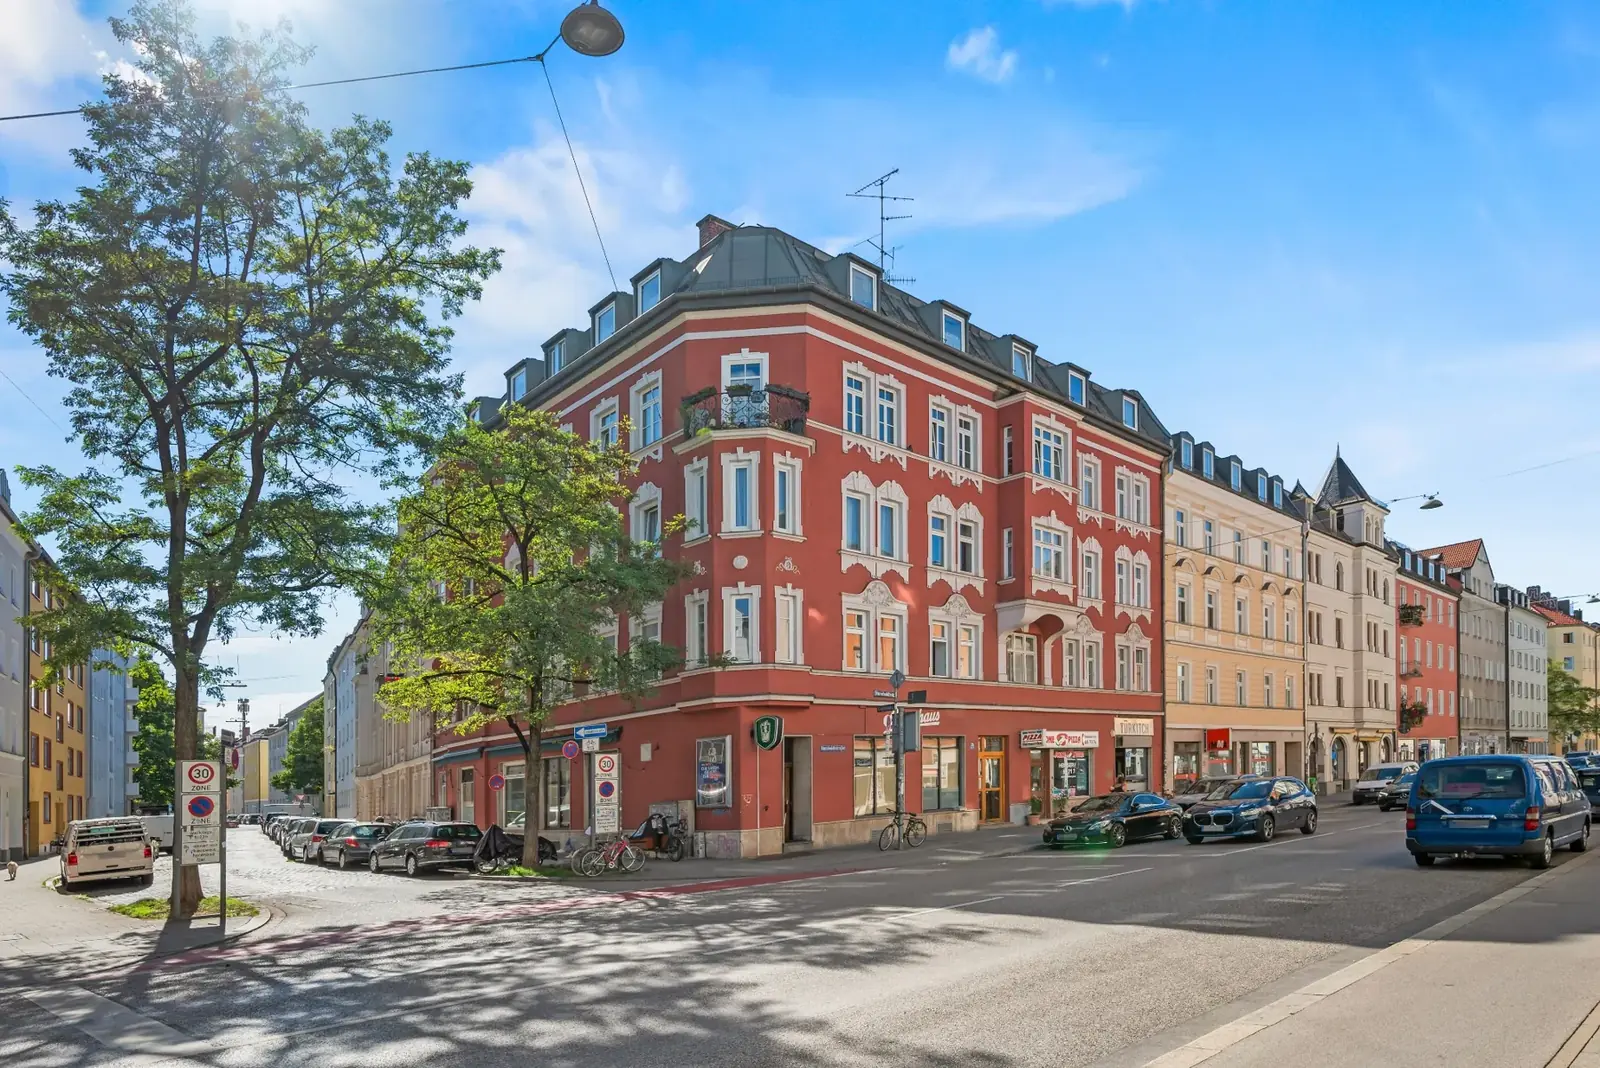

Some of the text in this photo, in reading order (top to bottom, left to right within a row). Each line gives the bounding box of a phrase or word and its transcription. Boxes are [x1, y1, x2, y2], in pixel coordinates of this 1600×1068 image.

[1023, 733, 1043, 741] PIZZA
[1067, 735, 1081, 744] PIZZA
[602, 760, 611, 768] 30
[193, 768, 209, 779] 30
